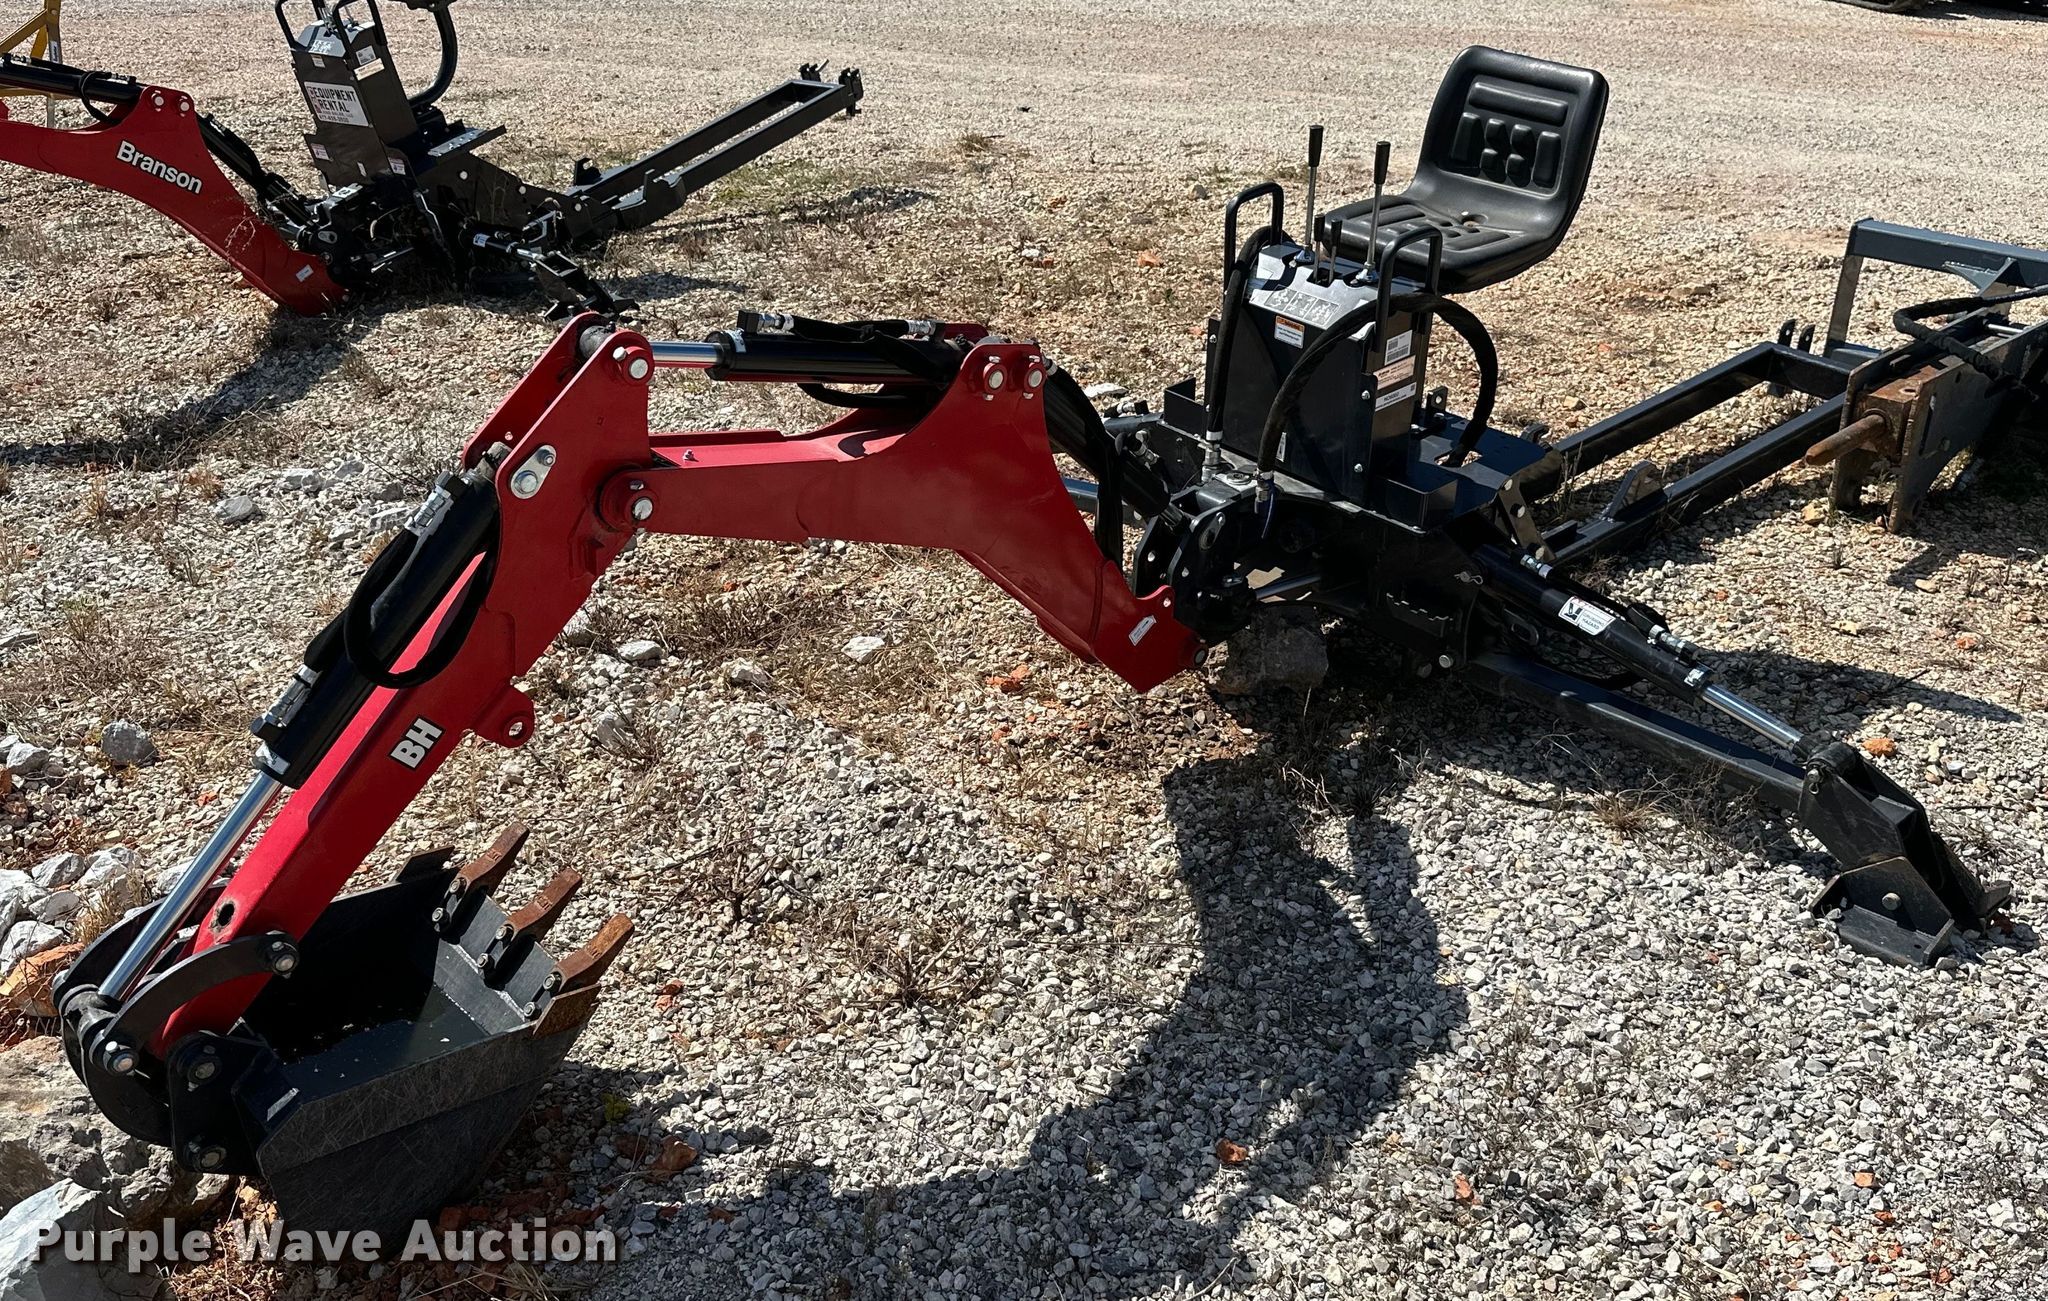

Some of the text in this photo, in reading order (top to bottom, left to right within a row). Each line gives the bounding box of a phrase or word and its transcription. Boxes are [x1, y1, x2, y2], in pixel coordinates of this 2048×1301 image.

[314, 87, 357, 102] EQUIPMENT
[319, 100, 350, 113] RENTAL
[117, 140, 203, 195] Branson
[390, 718, 443, 769] BH
